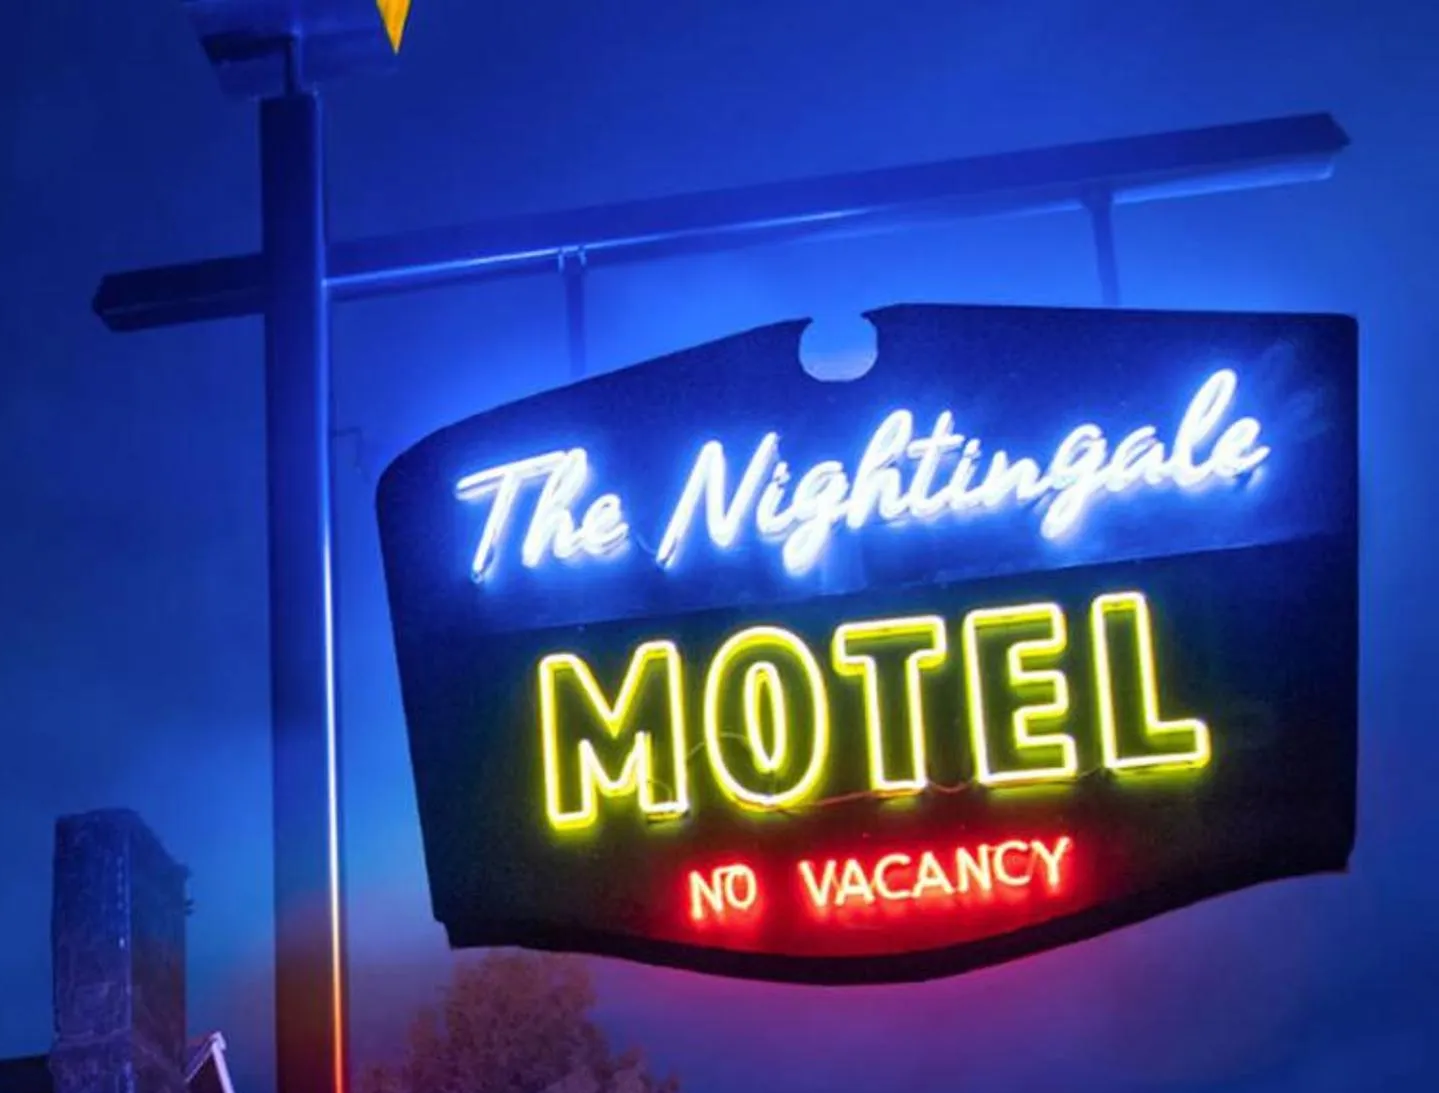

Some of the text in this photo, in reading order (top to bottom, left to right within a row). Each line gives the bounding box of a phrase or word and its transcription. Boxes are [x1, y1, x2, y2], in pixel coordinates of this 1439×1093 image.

[455, 368, 1270, 583] The Nightingale
[539, 591, 1211, 830] MOTEL
[688, 835, 1071, 921] NO VACANCY
